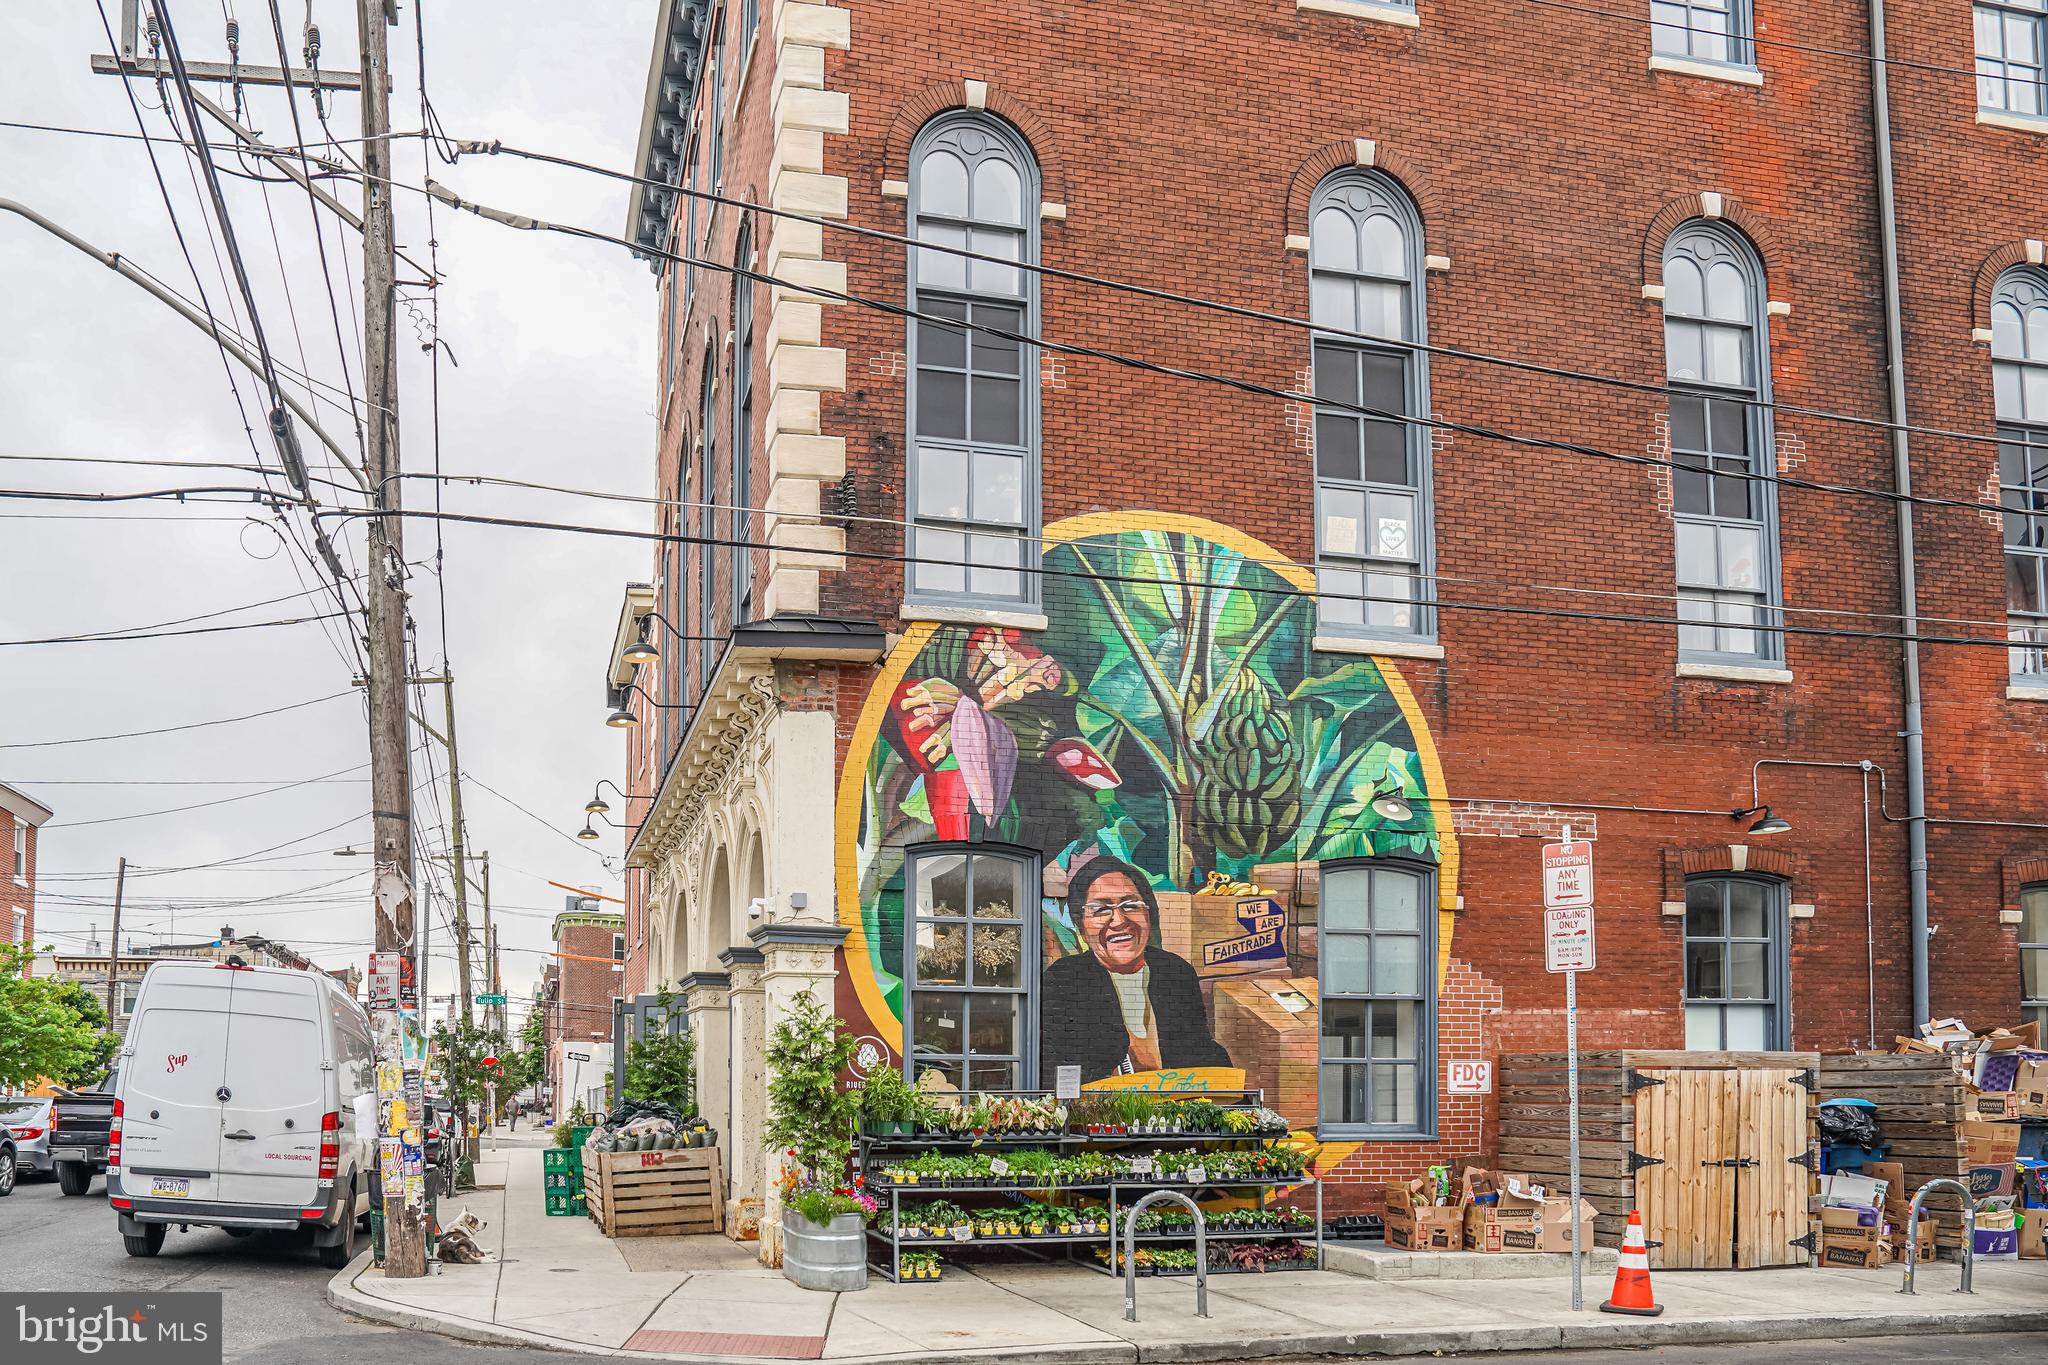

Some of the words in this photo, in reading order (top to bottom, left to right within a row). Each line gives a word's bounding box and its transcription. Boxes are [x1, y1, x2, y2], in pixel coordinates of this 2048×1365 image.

[1560, 845, 1574, 855] NO
[1546, 855, 1589, 867] STOPPING
[1558, 869, 1578, 880] ANY
[1557, 881, 1580, 891] TIME
[1246, 903, 1262, 915] WE
[1261, 917, 1279, 930] ARE
[1559, 920, 1579, 930] ONLY
[1212, 934, 1272, 961] FAIRTRADE
[376, 975, 390, 985] ANY
[376, 986, 391, 995] TIME
[167, 1054, 188, 1073] Sup
[1453, 1064, 1486, 1081] FDC
[1830, 1253, 1864, 1264] BANANAS
